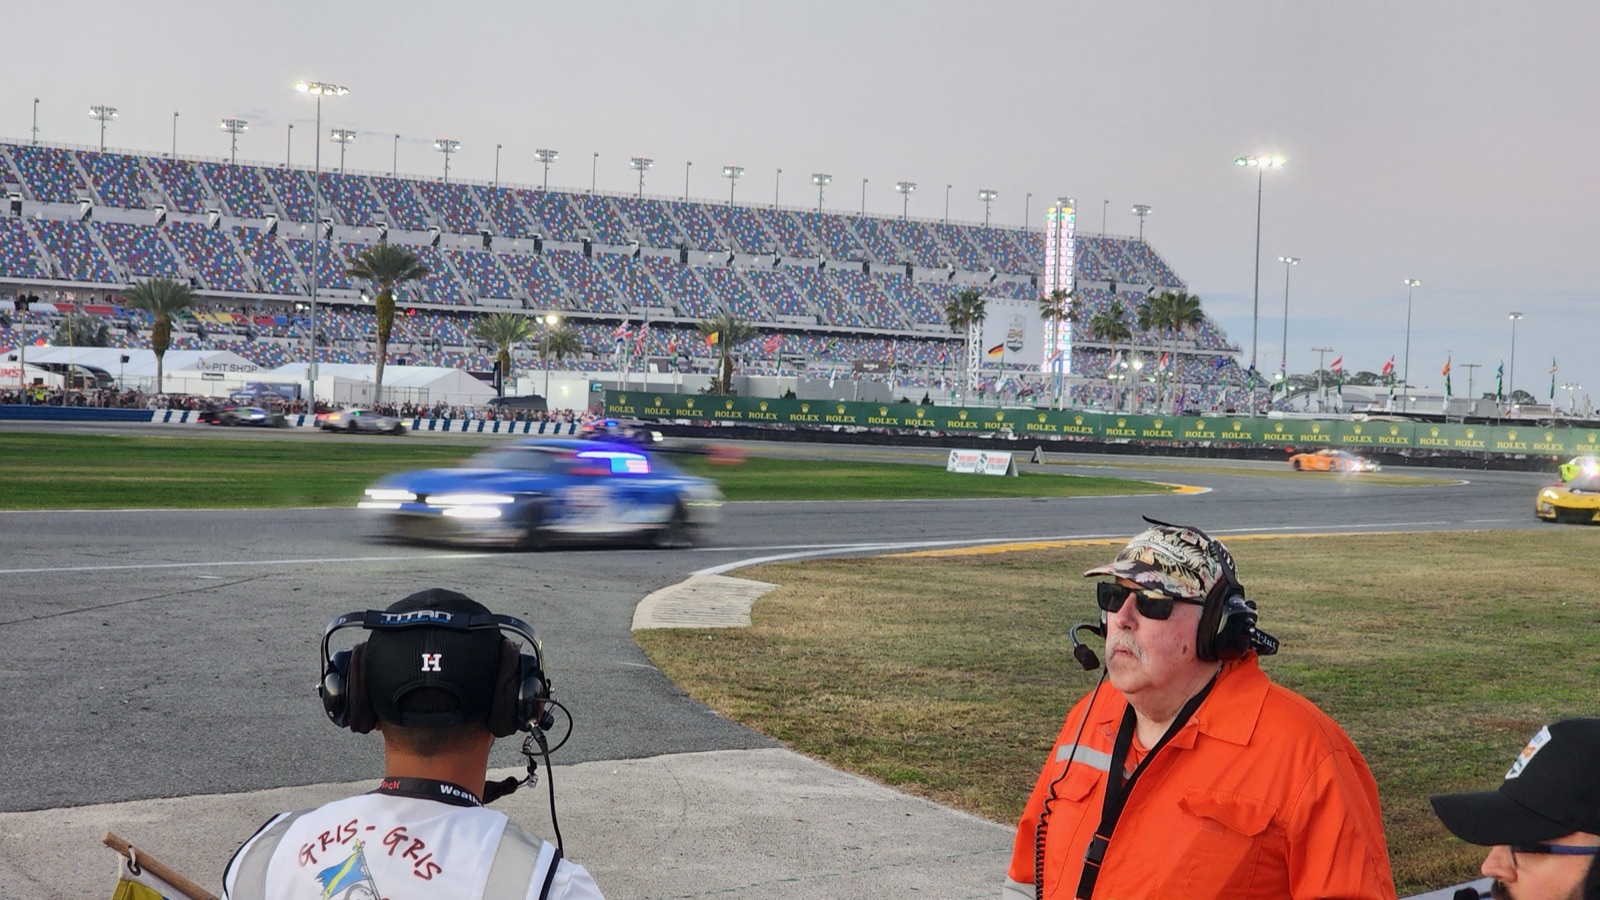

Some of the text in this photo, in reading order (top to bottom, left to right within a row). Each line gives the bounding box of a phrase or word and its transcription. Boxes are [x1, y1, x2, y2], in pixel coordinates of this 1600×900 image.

[212, 363, 258, 373] PIT SHOP
[610, 405, 635, 414] ROLEX
[645, 407, 670, 415] ROLEX
[676, 408, 703, 417] ROLEX
[715, 410, 742, 418] ROLEX
[749, 412, 777, 420] ROLEX
[790, 414, 819, 422] ROLEX
[826, 415, 855, 423] ROLEX
[868, 416, 898, 425] ROLEX
[905, 418, 935, 427] ROLEX
[948, 420, 978, 429] ROLEX
[984, 422, 1015, 430] ROLEX
[1026, 423, 1057, 432] ROLEX
[1064, 425, 1093, 434] ROLEX
[1106, 427, 1136, 436] ROLEX
[1143, 429, 1173, 438] ROLEX
[1185, 430, 1215, 439] ROLEX
[1222, 432, 1252, 440] ROLEX
[1264, 433, 1294, 442] ROLEX
[1342, 435, 1373, 443] ROLEX
[1379, 436, 1409, 444] ROLEX
[1420, 438, 1448, 446] ROLEX
[1455, 439, 1485, 448] ROLEX
[1497, 442, 1527, 450] ROLEX
[1534, 443, 1564, 451] ROLEX
[1576, 444, 1600, 452] ROLE
[381, 610, 452, 622] TITAN
[421, 654, 442, 672] H
[382, 780, 399, 790] Tech
[298, 818, 358, 868] GRIS
[382, 826, 442, 880] GRIS
